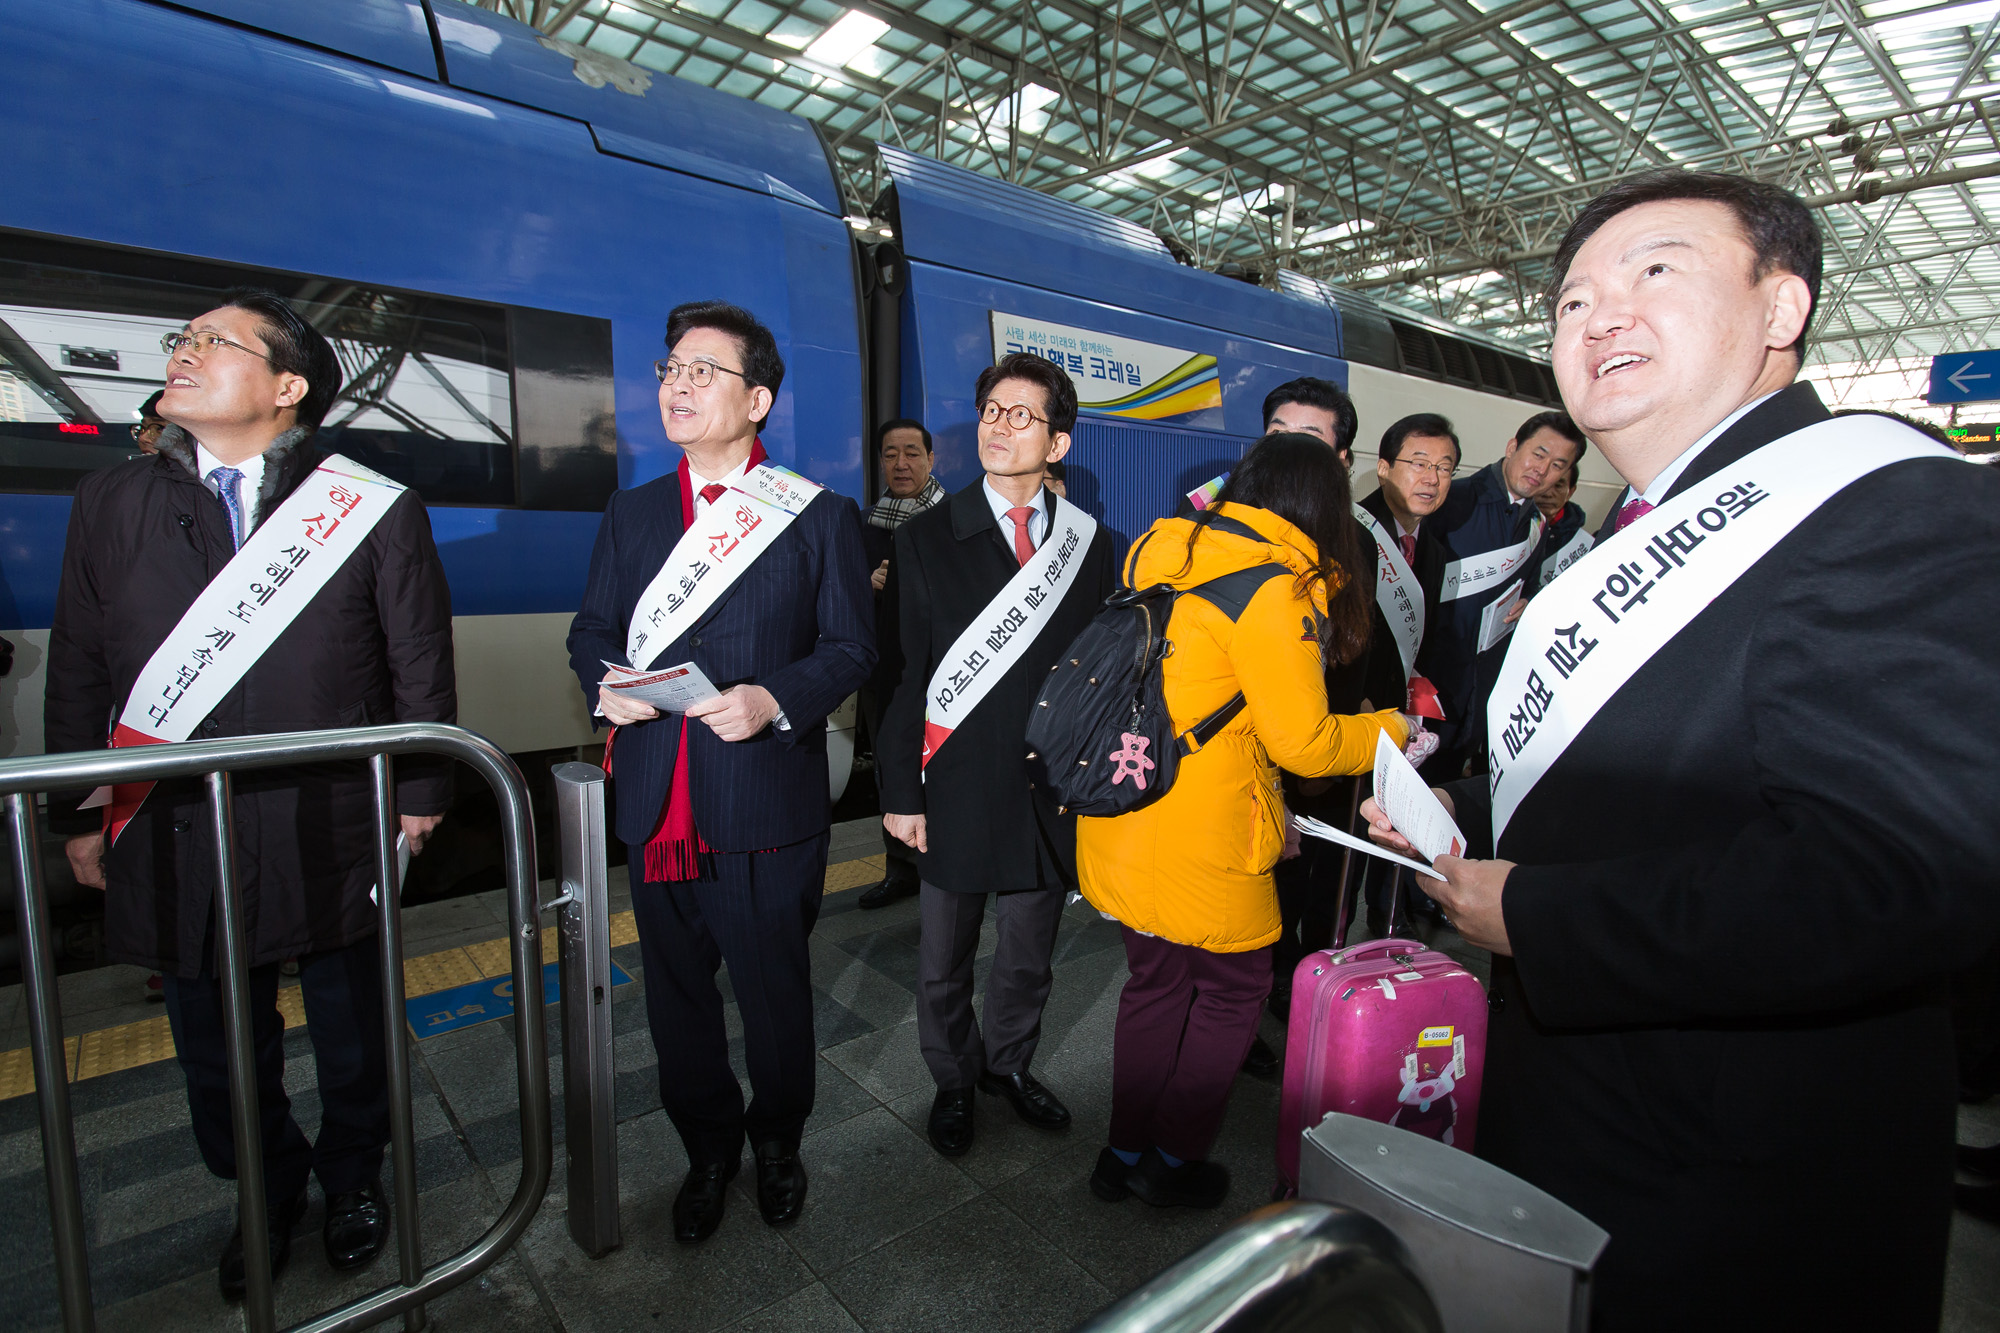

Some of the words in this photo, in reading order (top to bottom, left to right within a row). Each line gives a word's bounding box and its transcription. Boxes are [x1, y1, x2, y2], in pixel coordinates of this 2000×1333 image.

[1005, 326, 1024, 341] 사람
[1029, 330, 1047, 345] 세상
[1050, 334, 1077, 350] 미래와
[1080, 340, 1113, 357] 함께하는
[1089, 356, 1142, 387] 코레일
[1945, 428, 1968, 436] rain
[302, 483, 363, 547] 혁신
[759, 480, 791, 507] 받으세요
[790, 490, 807, 506] 많이
[708, 505, 763, 563] 혁신
[1044, 526, 1079, 586] 행복한
[1592, 481, 1771, 624] 행복한
[228, 544, 311, 624] 새해에도
[648, 560, 711, 628] 새해에도
[1024, 585, 1047, 611] 설
[1446, 565, 1498, 587] 새해에도
[985, 606, 1028, 654] 명절
[1393, 585, 1418, 637] 새해에도
[148, 626, 237, 728] 계속됩니다
[1545, 622, 1599, 680] 설
[935, 650, 990, 712] 되세요
[1501, 668, 1554, 761] 명절
